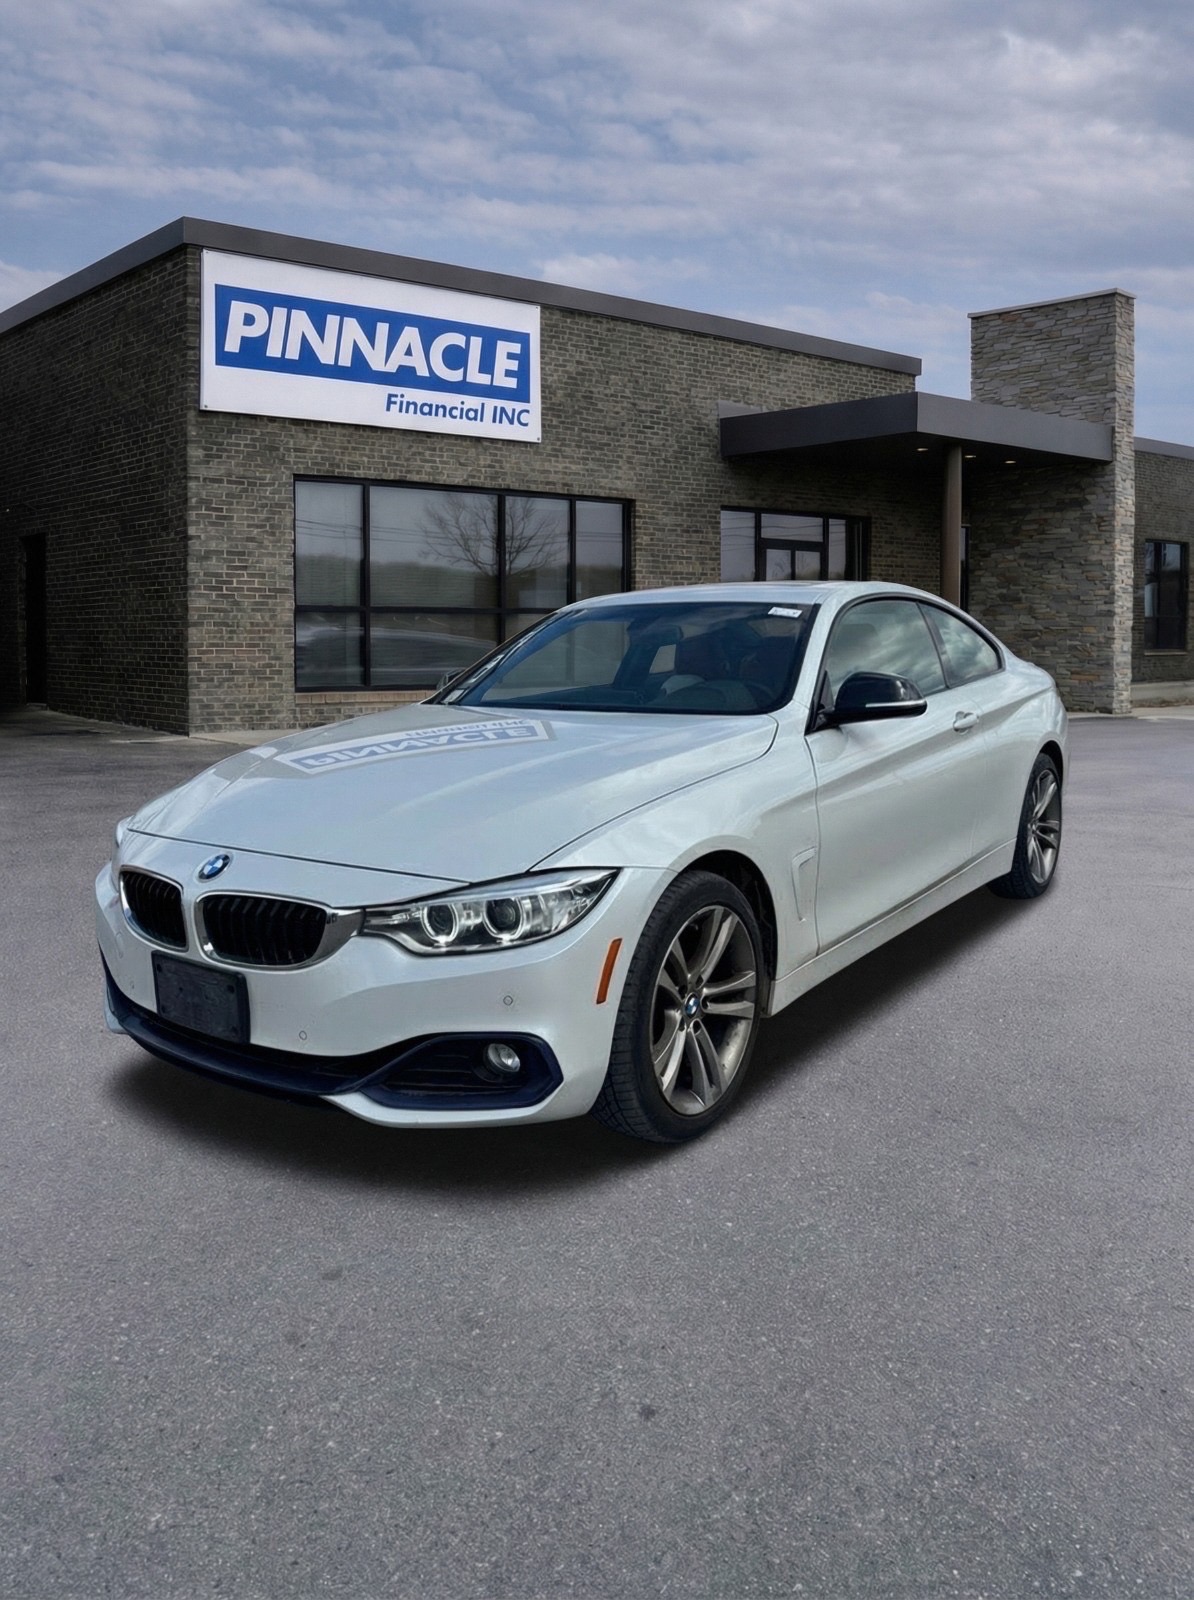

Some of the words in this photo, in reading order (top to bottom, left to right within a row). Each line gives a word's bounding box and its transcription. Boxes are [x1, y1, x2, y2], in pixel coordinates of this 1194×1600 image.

[224, 300, 521, 389] PINNACLE
[386, 393, 485, 422] Financial
[492, 405, 530, 427] INC
